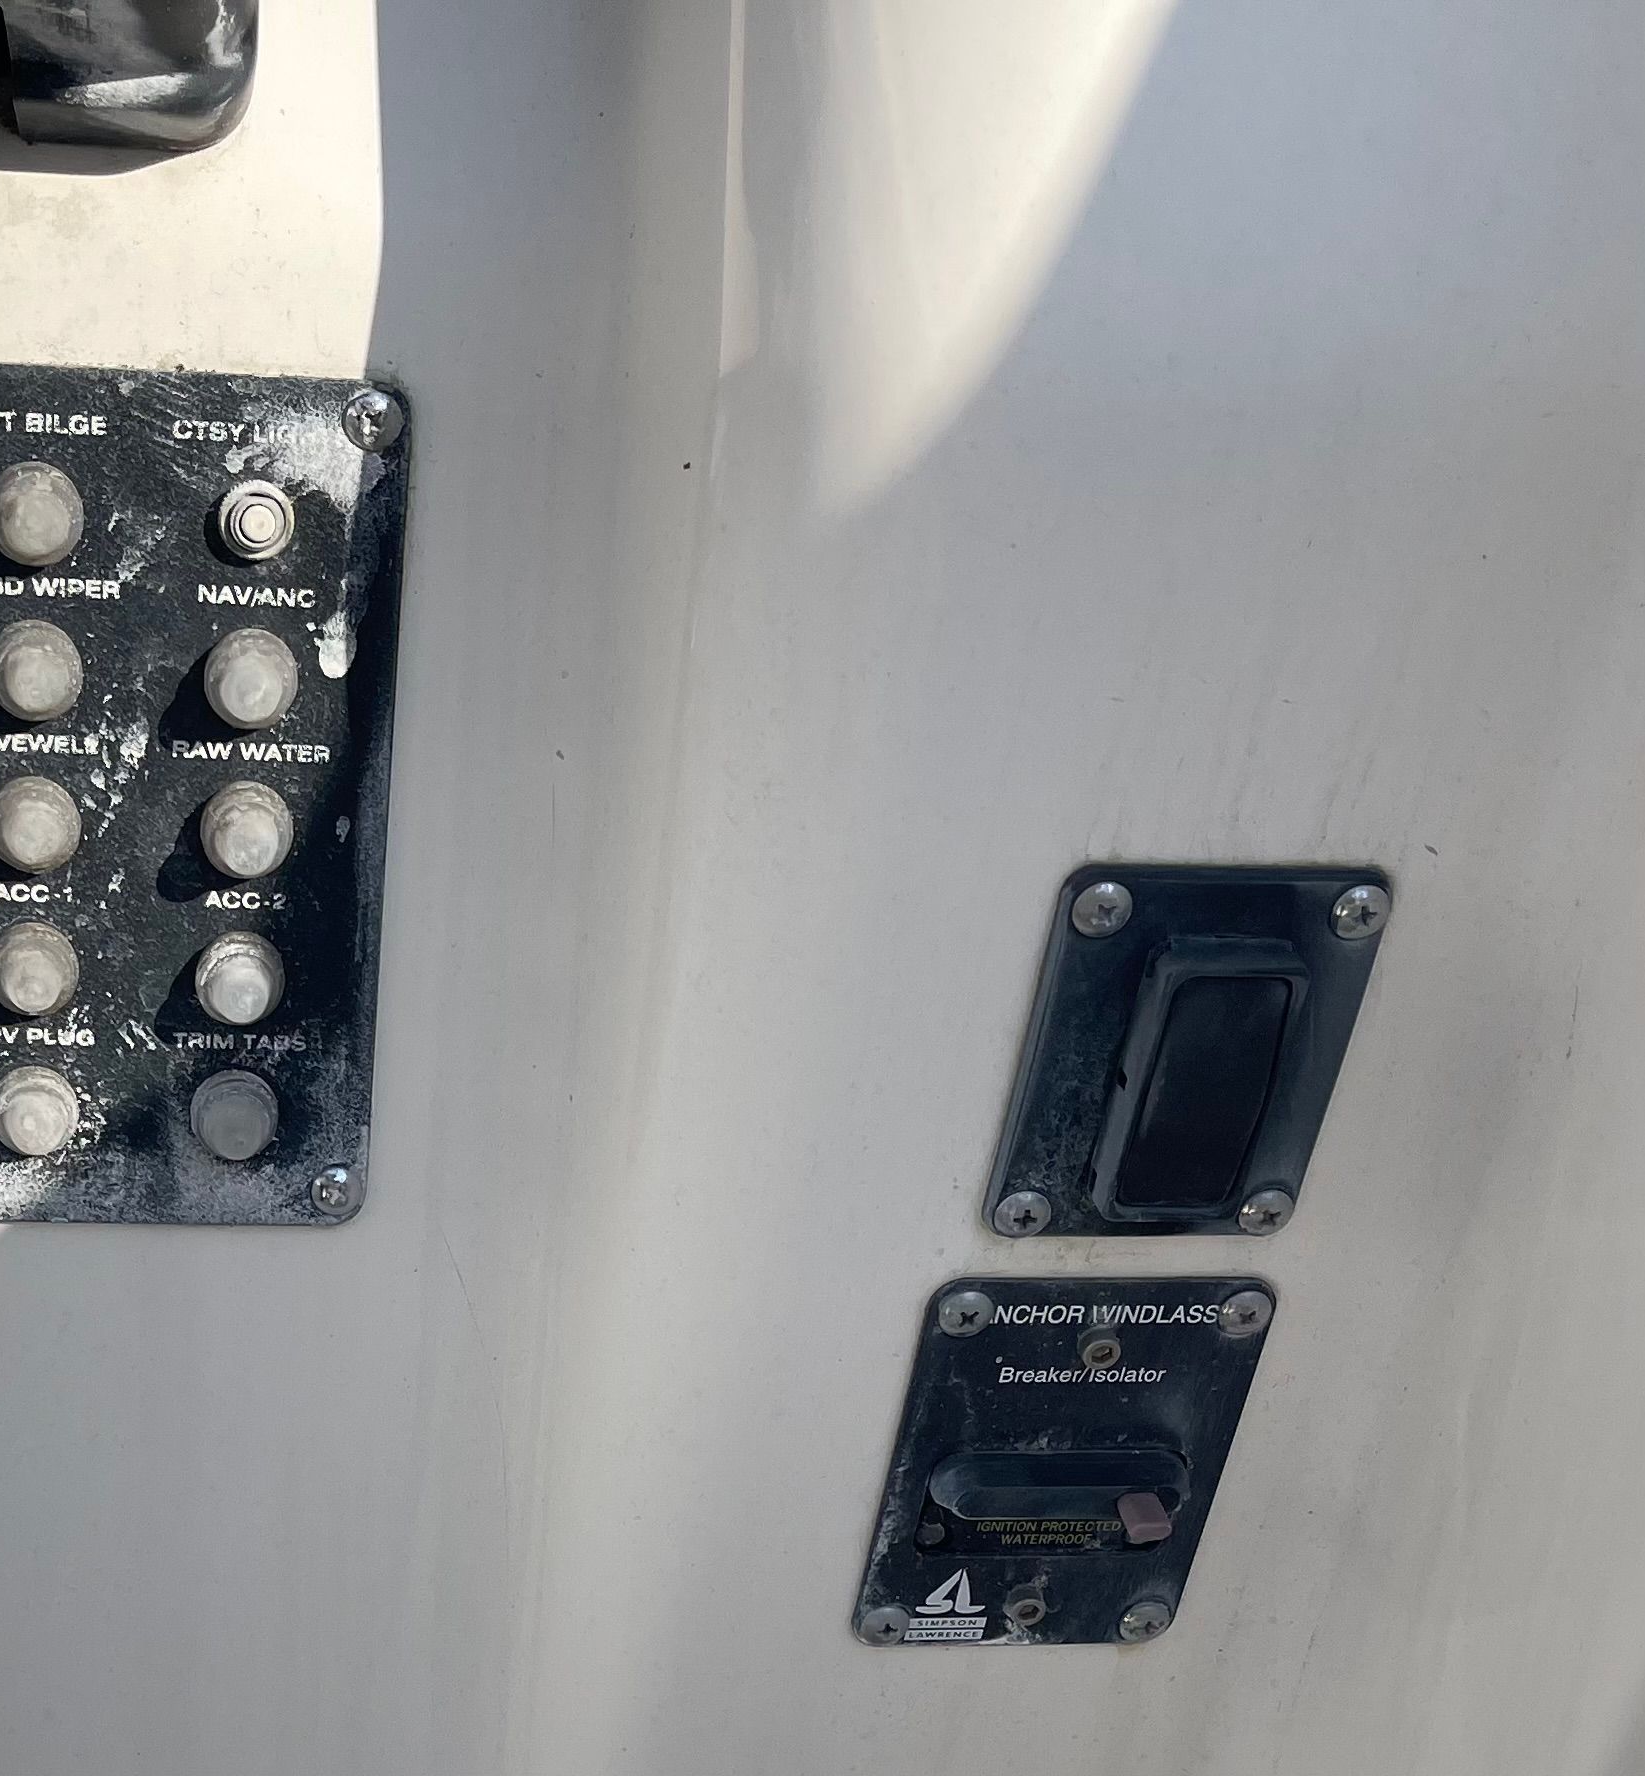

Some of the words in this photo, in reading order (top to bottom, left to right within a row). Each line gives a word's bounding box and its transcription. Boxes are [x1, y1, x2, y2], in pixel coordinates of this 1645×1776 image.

[25, 412, 108, 436] BILGE
[172, 419, 245, 442] CTSY
[31, 576, 121, 600] WIPER
[197, 583, 316, 609] NAV/ANC
[172, 740, 233, 761] RAW
[239, 742, 331, 763] WATER
[26, 1027, 96, 1047] PLUG
[172, 1032, 234, 1050] TRIM
[243, 1034, 307, 1051] TABS
[989, 1305, 1085, 1325] NCHOR
[1092, 1304, 1220, 1324] WINDLASS
[976, 1521, 1037, 1532] IGNITION
[1040, 1520, 1122, 1532] PROTECTED
[1000, 1533, 1093, 1545] WATERPROOF
[917, 1619, 978, 1627] SIMPSON
[908, 1630, 979, 1639] LAWRENCE
